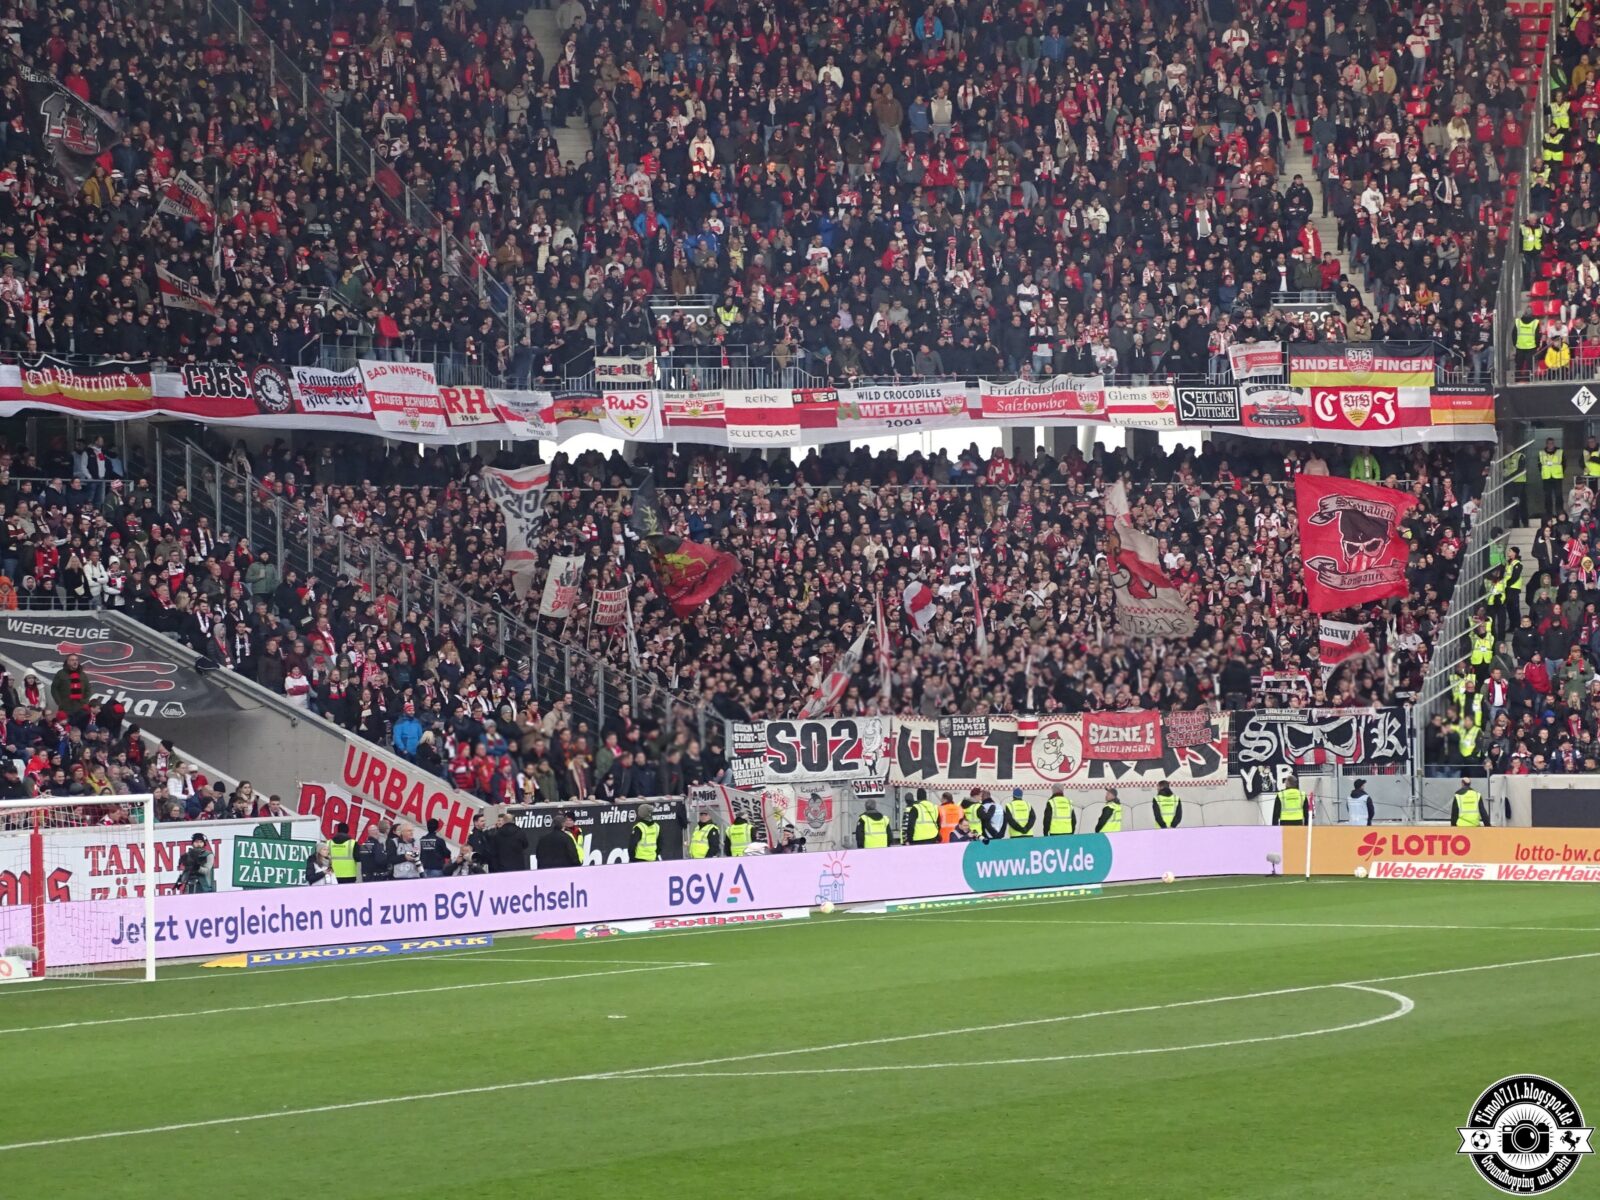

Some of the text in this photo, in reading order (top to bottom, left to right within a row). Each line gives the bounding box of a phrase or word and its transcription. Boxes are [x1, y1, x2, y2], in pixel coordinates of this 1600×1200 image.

[366, 365, 435, 384] BAD WIMPFEN
[1291, 358, 1347, 371] SINDEL
[1374, 359, 1432, 371] FINGEN
[441, 388, 491, 414] RH
[857, 389, 942, 401] WILD CROCODILES
[1108, 390, 1148, 401] Glems
[859, 401, 944, 417] WELZHEIM
[886, 418, 922, 428] 2004
[7, 618, 110, 639] WERKZEUGE
[952, 723, 986, 731] IMMER
[1089, 722, 1155, 745] SZENE E
[343, 744, 475, 846] URBACH
[515, 810, 543, 829] wiha
[600, 806, 628, 824] wiha
[237, 840, 313, 861] TANNEN
[1392, 834, 1471, 856] LOTTO
[976, 847, 1094, 879] www.BGV.de
[1376, 862, 1485, 880] WeberHaus
[669, 872, 724, 906] BGV
[186, 903, 323, 945] vergleichen
[330, 897, 373, 928] und
[380, 900, 427, 925] zum
[436, 890, 483, 922] BGV
[490, 884, 588, 916] wechseln
[250, 936, 488, 964] EUROPA PARK
